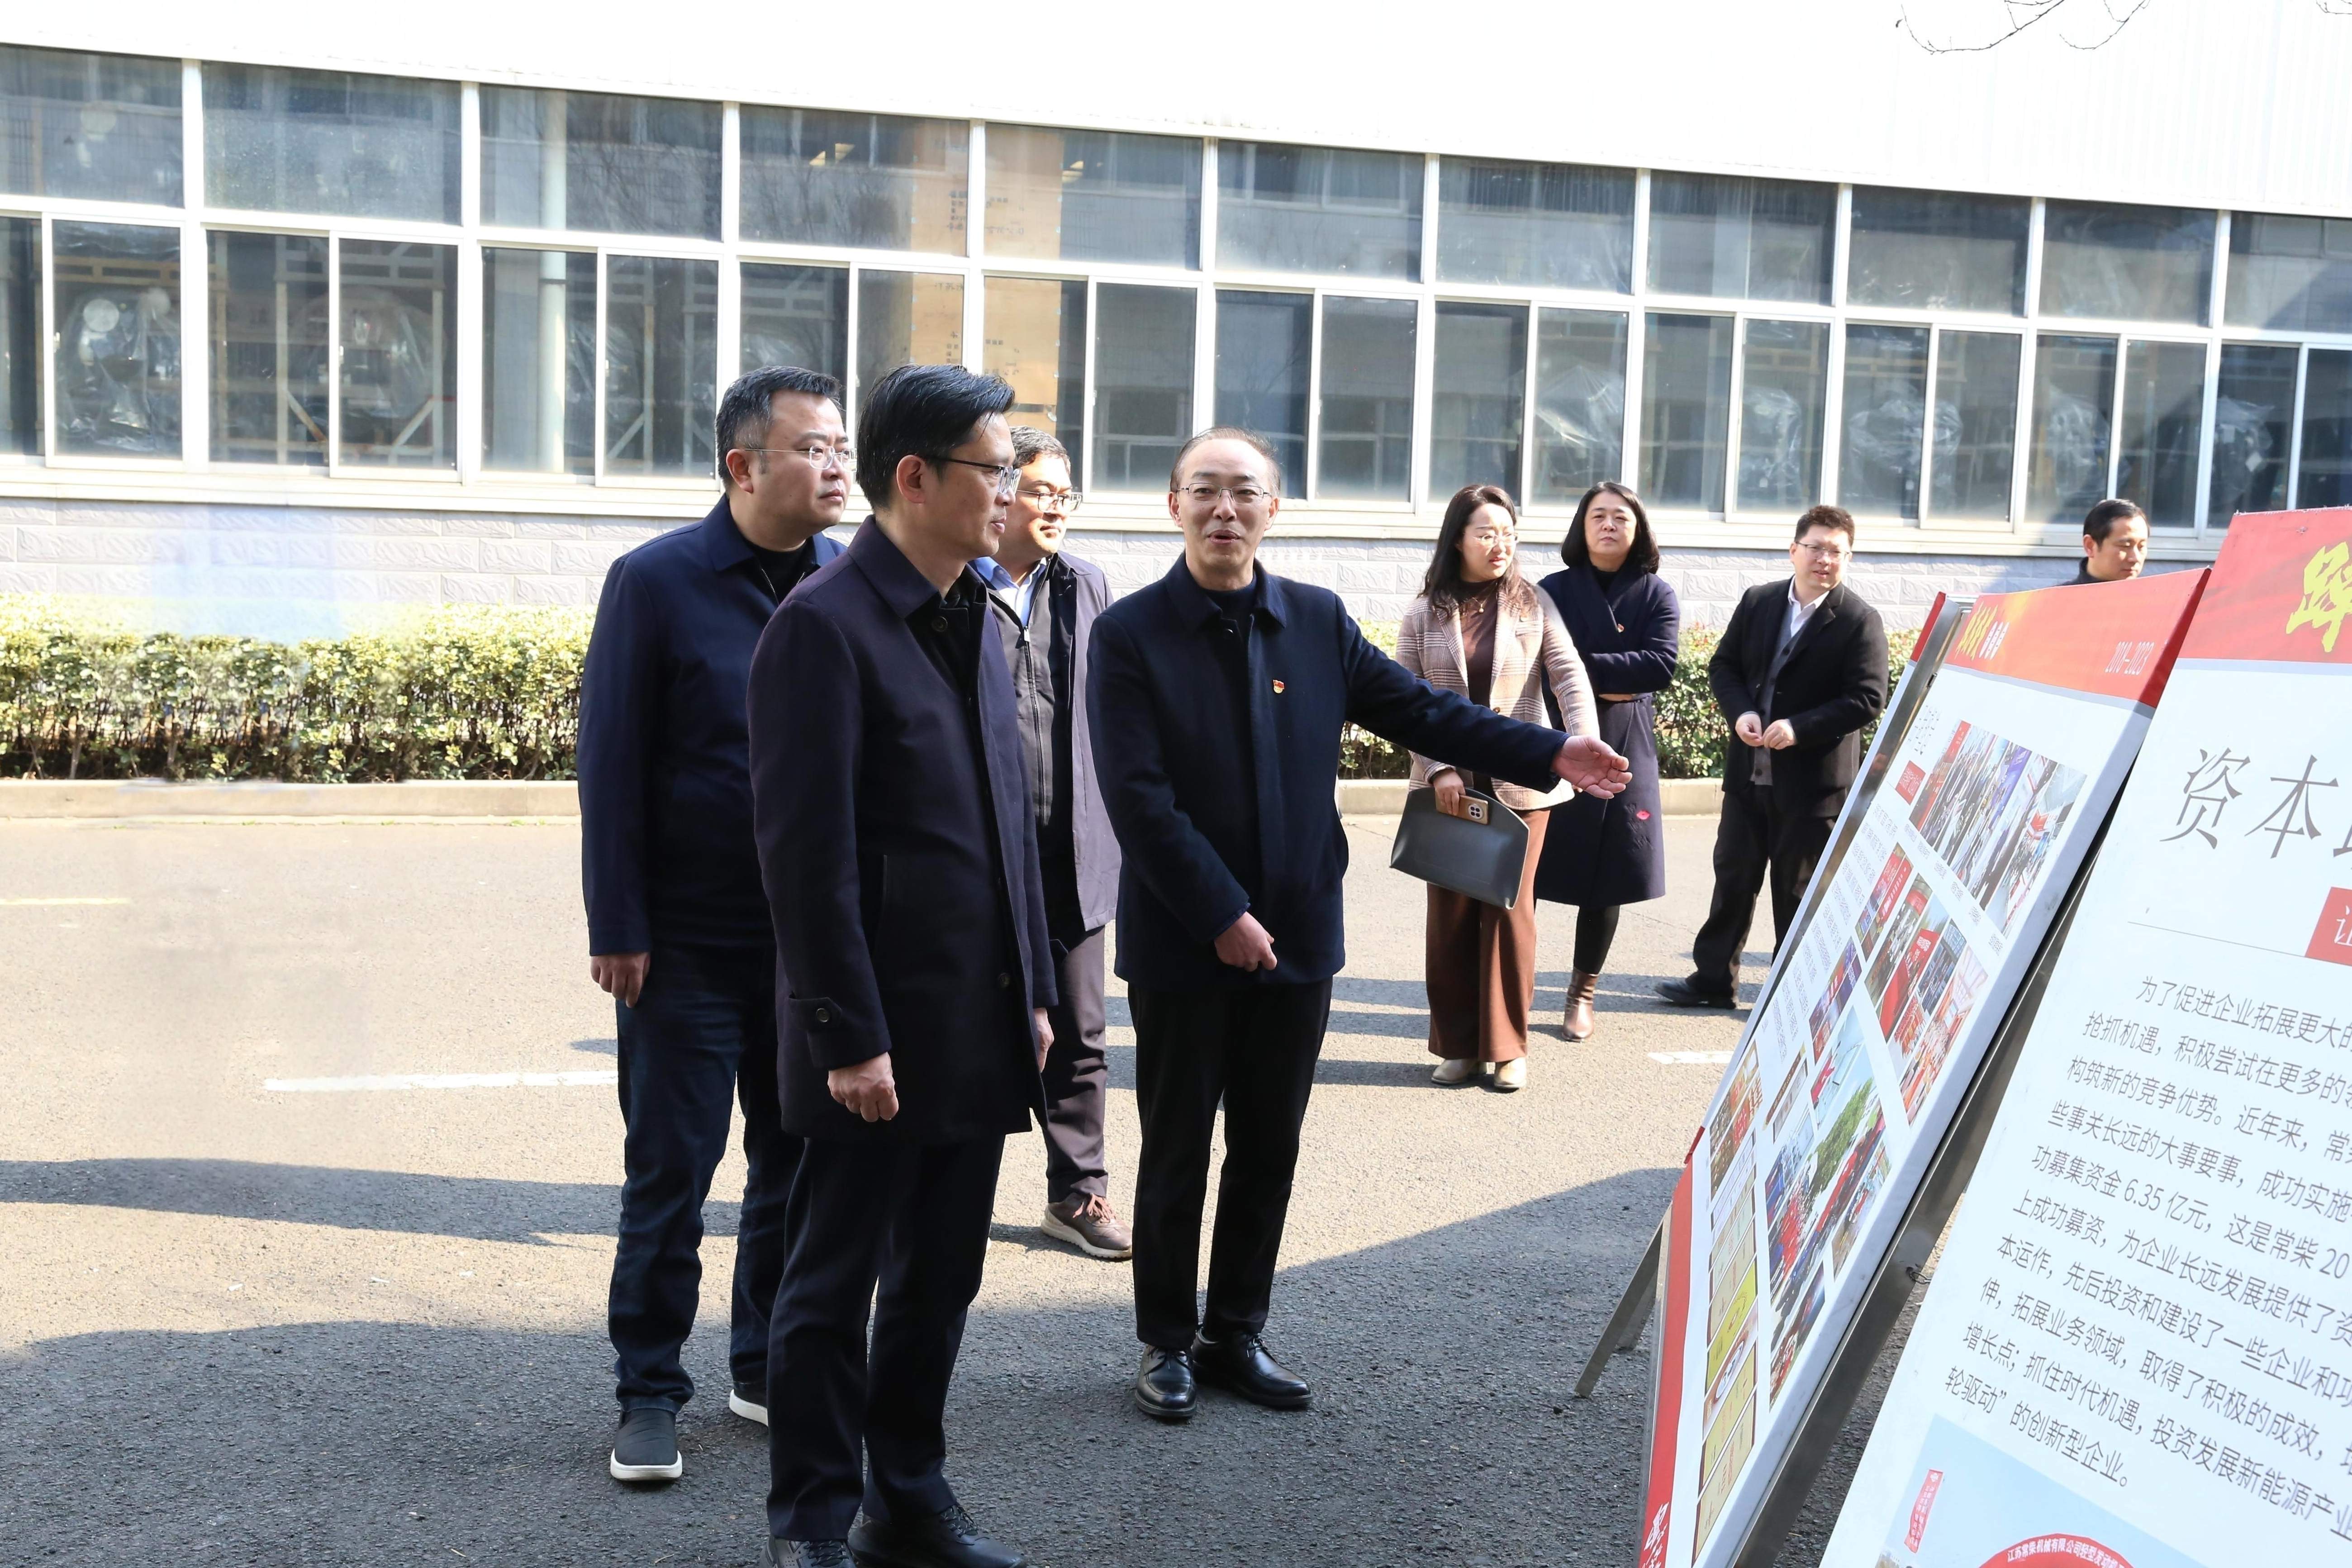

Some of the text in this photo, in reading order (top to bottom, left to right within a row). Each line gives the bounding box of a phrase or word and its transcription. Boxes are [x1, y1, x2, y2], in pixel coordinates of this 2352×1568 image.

[2159, 748, 2352, 858] 资本
[2067, 1055, 2352, 1164] 构筑新的竞争优势。近年来，常
[2083, 1011, 2352, 1109] 抢抓机遇，积极尝试在更多的
